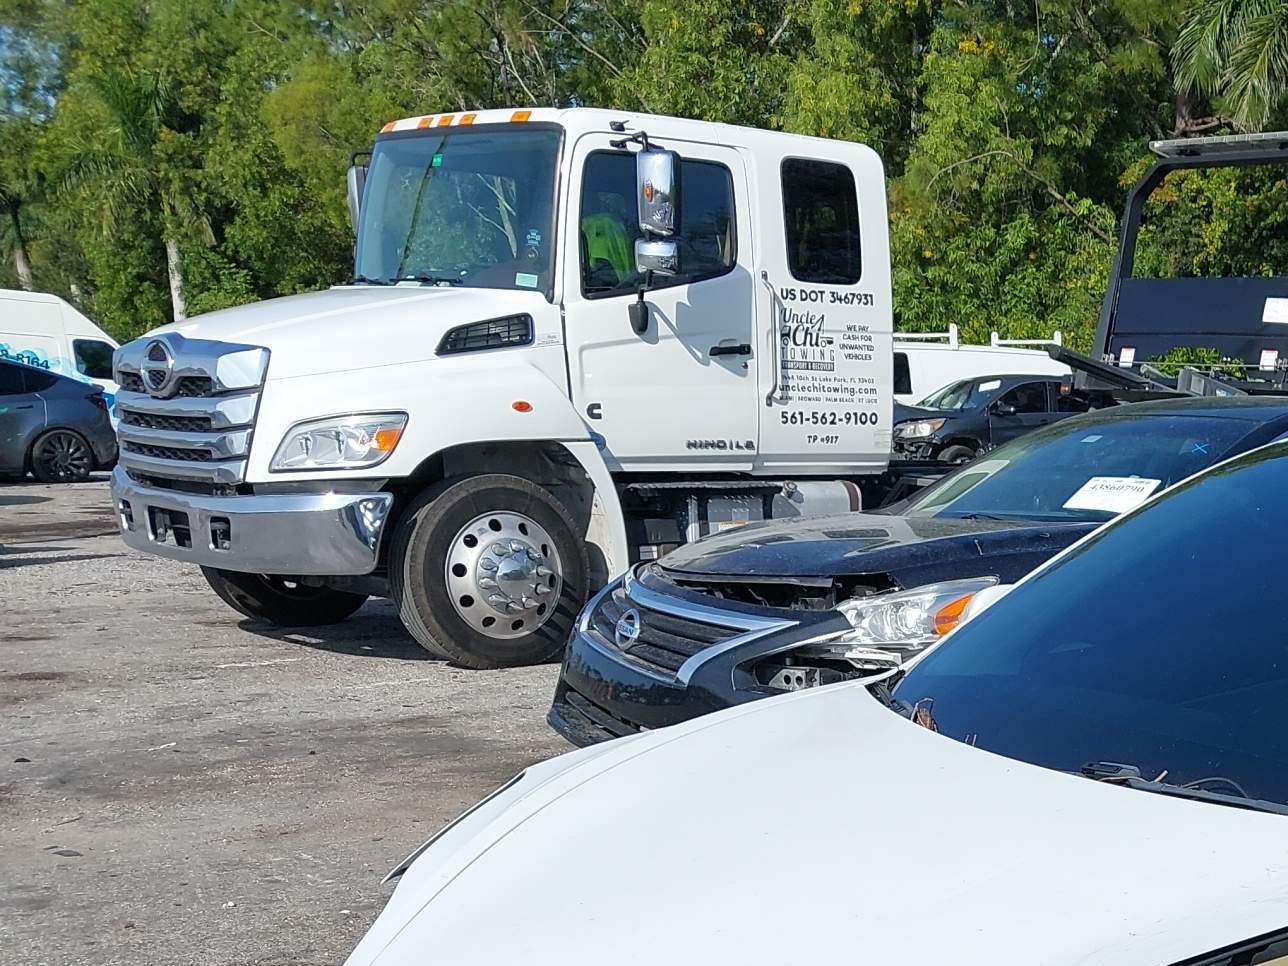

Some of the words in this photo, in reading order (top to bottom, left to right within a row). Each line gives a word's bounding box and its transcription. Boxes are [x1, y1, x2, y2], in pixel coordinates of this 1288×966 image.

[780, 287, 797, 301] US
[799, 288, 826, 303] DOT
[829, 291, 874, 306] 3467931
[783, 307, 817, 324] Uncle
[846, 324, 857, 332] WE
[858, 325, 870, 333] PAY
[792, 324, 820, 348] Chi
[842, 333, 860, 342] CASH
[860, 334, 873, 343] FOR
[781, 347, 835, 361] TOWING
[839, 343, 875, 352] UNWANTED
[844, 353, 873, 361] VEHICLES
[778, 382, 878, 397] unclechitowing.com
[780, 410, 879, 426] 561-562-9100
[807, 434, 818, 444] TP
